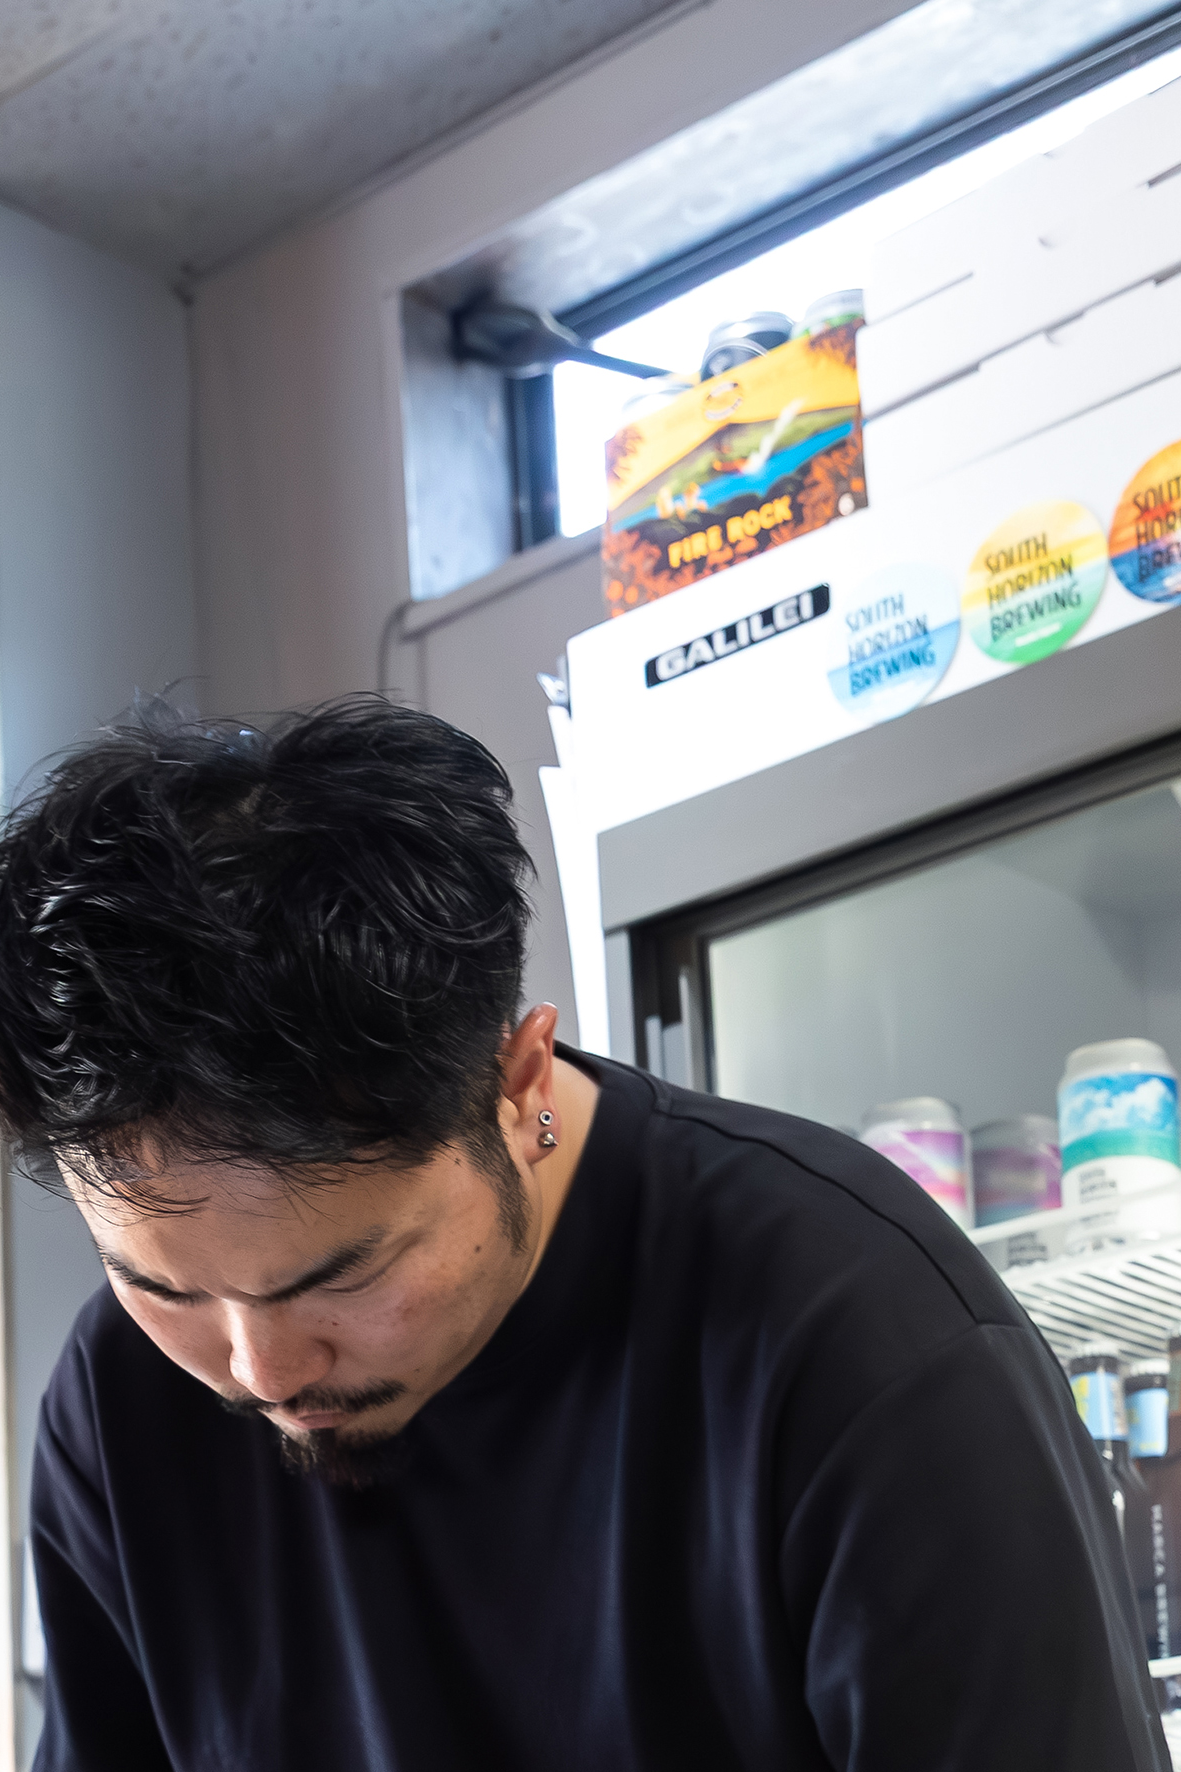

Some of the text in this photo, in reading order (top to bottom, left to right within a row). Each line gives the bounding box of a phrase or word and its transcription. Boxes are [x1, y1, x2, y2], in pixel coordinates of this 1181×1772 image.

[668, 495, 793, 569] FIRE ROCK
[985, 531, 1048, 576] SOUTH
[986, 553, 1073, 610] HORIZON
[655, 590, 815, 682] GALILEI
[845, 592, 905, 633] SOUTH
[848, 613, 929, 667] HORIZON
[990, 581, 1082, 643] BREWING
[849, 640, 937, 698] BREWING
